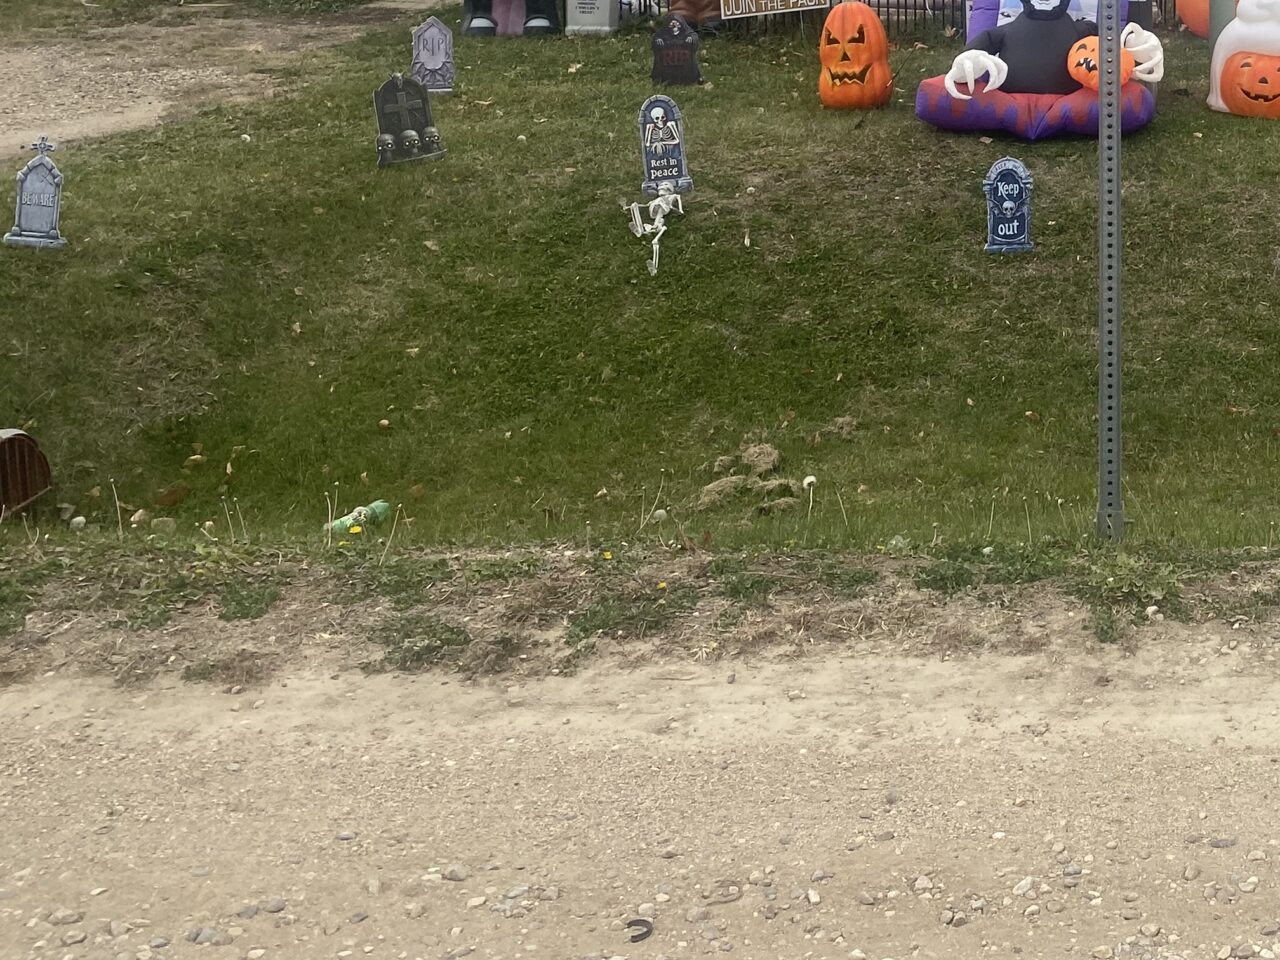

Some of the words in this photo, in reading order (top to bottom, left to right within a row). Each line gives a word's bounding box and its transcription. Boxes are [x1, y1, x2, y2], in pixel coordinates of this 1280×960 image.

[422, 37, 445, 57] RIP
[669, 157, 678, 166] in
[21, 191, 56, 208] BEWARE
[997, 181, 1020, 201] Keep
[998, 219, 1020, 236] out
